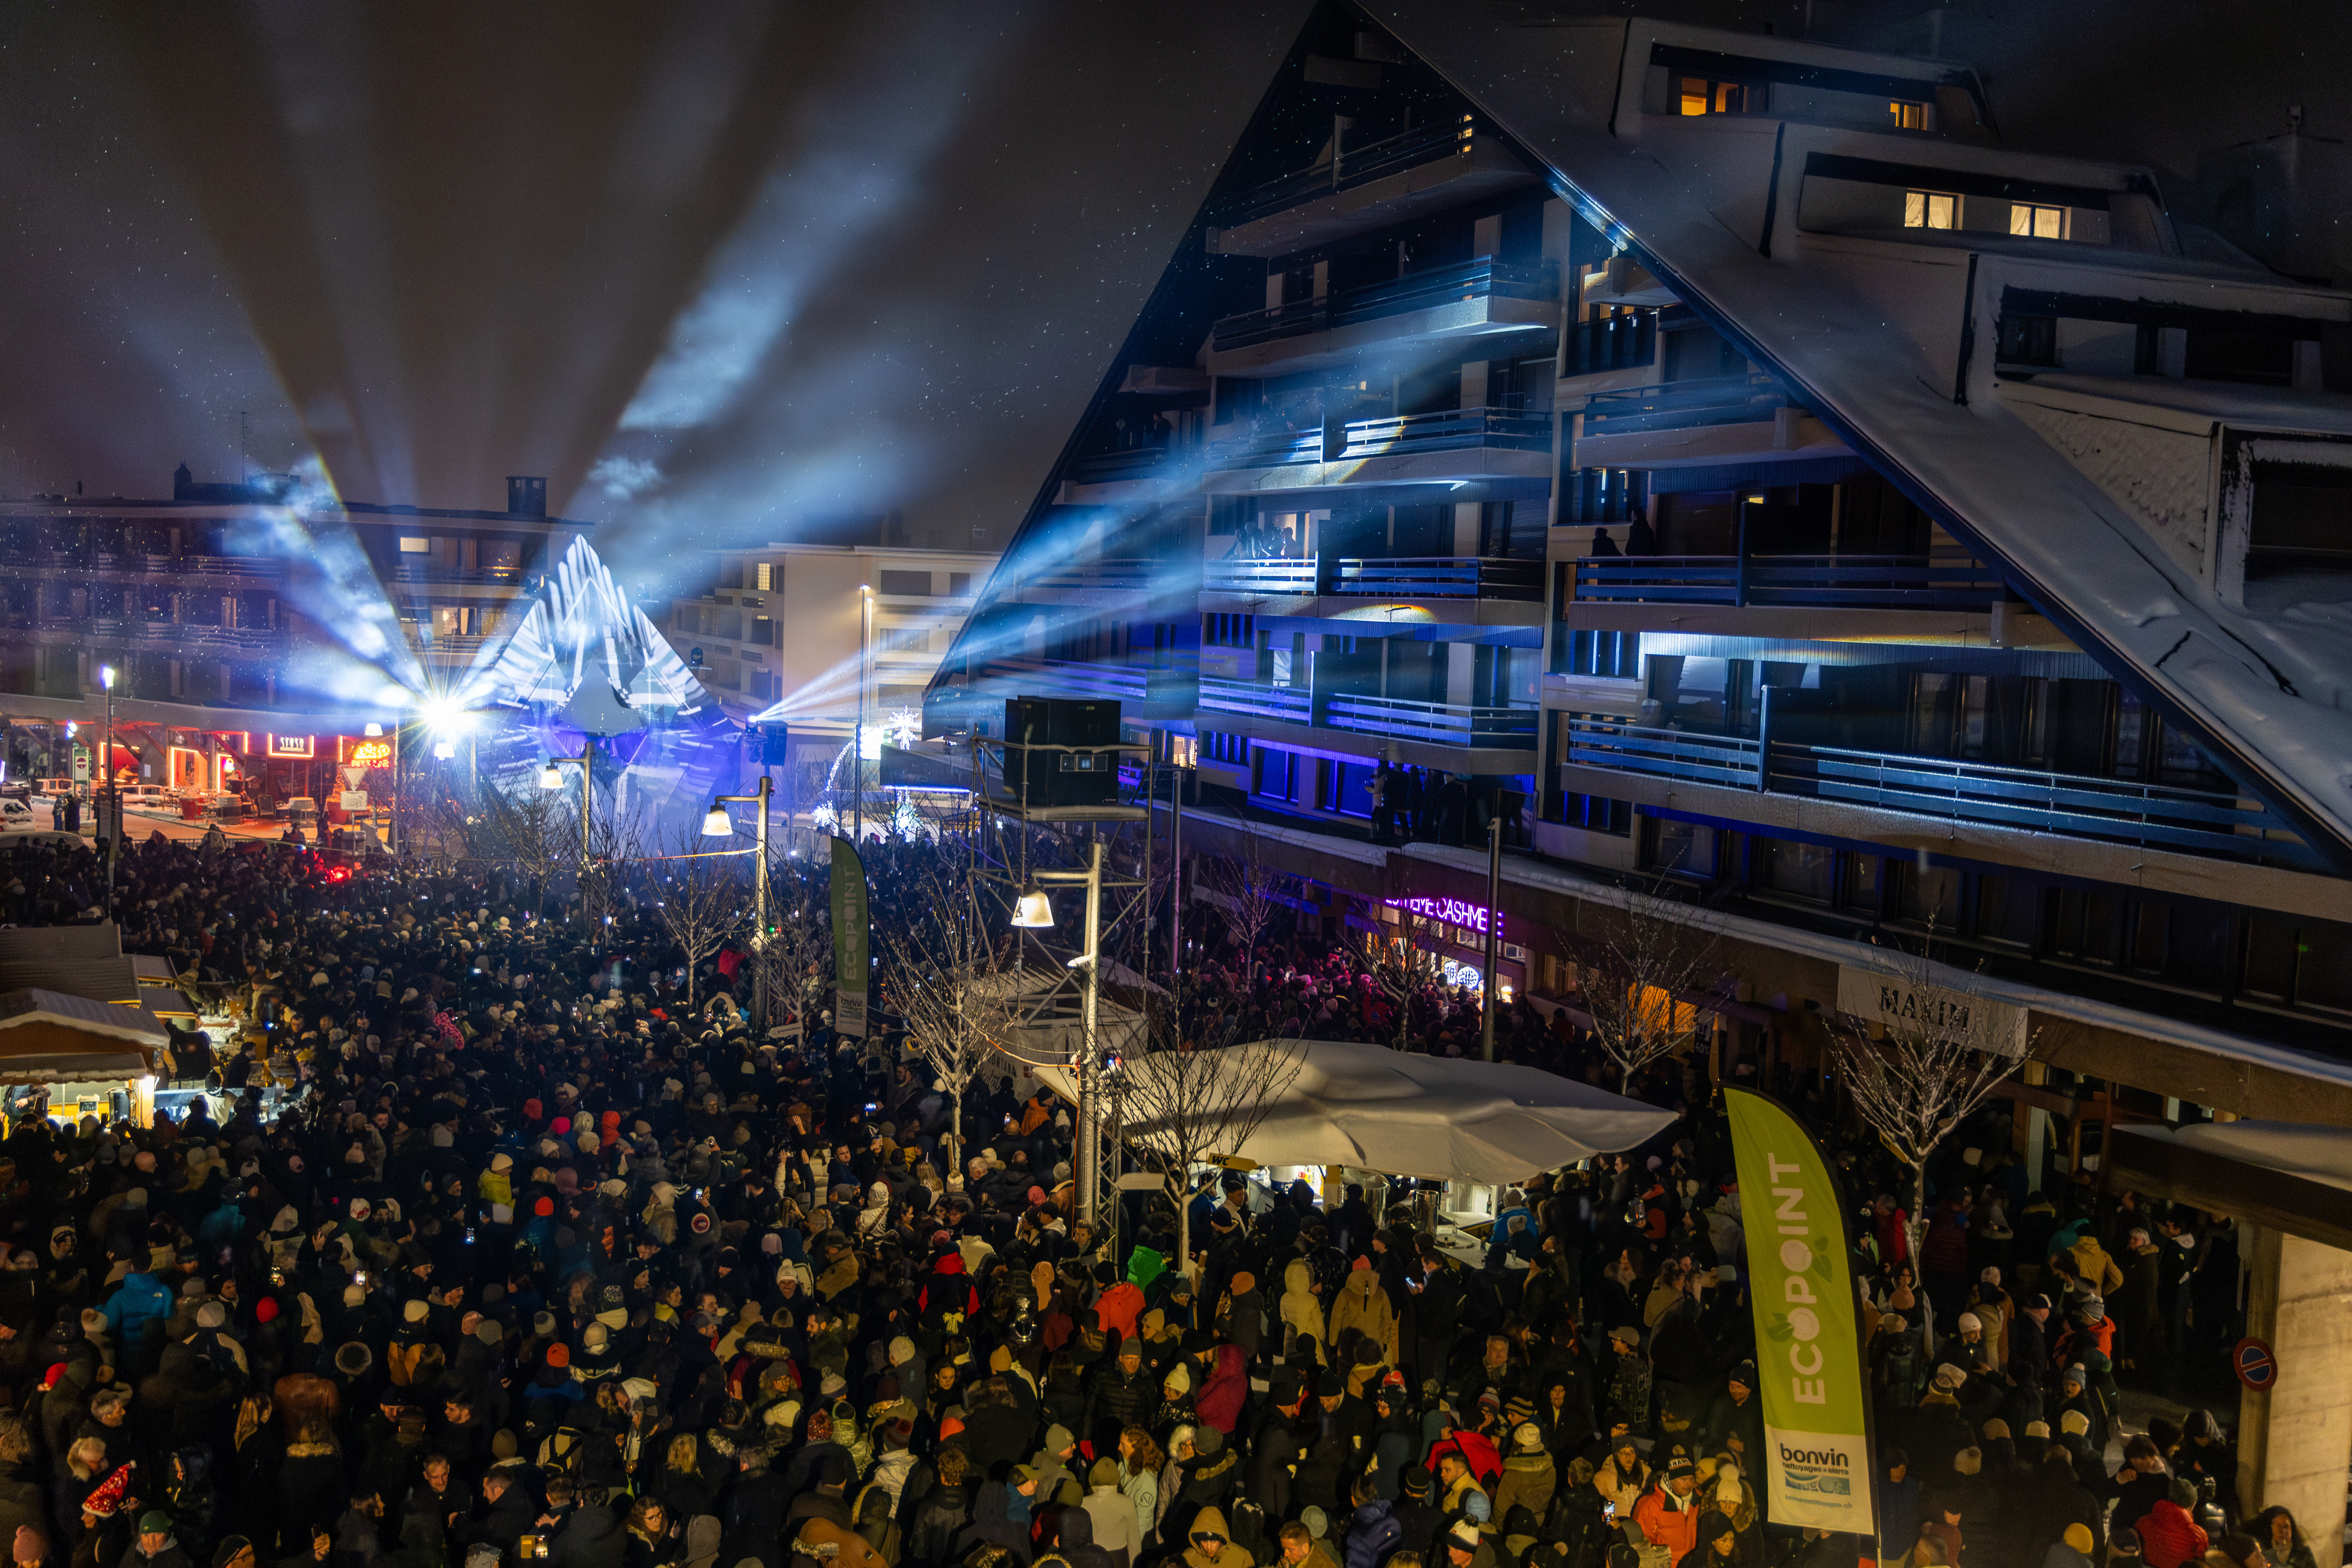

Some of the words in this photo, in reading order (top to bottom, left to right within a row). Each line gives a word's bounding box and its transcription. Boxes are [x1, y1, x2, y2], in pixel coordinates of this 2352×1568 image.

[280, 737, 304, 752] SENSO
[844, 865, 857, 980] ECOPOINT
[1436, 898, 1503, 936] CASHMEE
[1212, 1155, 1230, 1166] WC
[1767, 1152, 1826, 1405] ECOPOINT
[1780, 1443, 1849, 1467] bonvin
